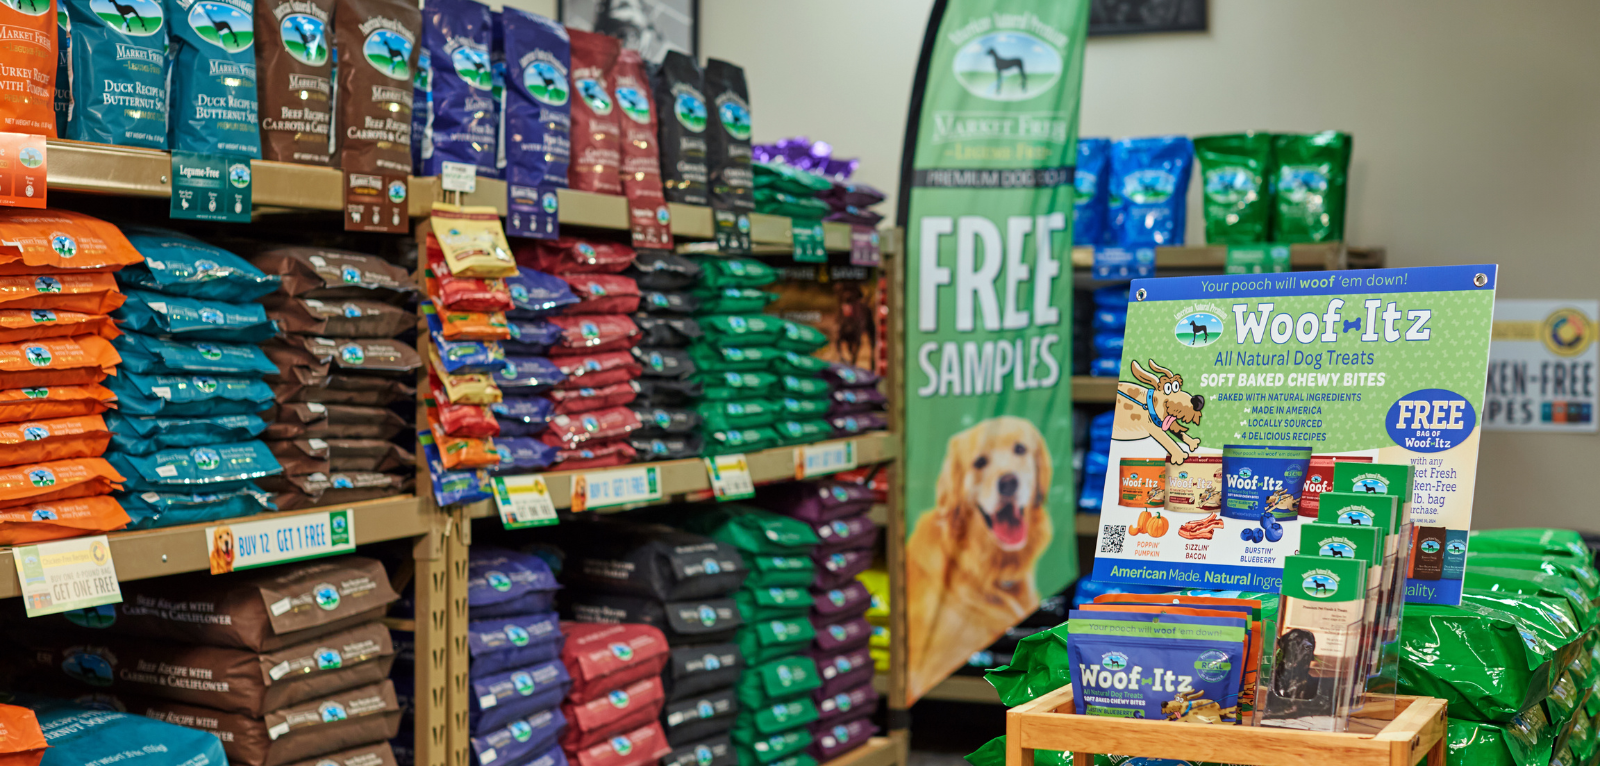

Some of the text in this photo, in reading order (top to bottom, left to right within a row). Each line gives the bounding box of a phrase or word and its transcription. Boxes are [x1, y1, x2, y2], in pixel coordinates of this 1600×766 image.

[117, 45, 147, 60] MARKET
[210, 60, 239, 75] MARKET
[104, 80, 134, 93] DUCK
[103, 93, 154, 109] BUTTERNUT
[198, 94, 226, 106] DUCK
[196, 107, 246, 121] BUTTERNUT
[263, 118, 305, 132] CARROTS
[932, 113, 1013, 142] MARKET
[180, 165, 219, 178] Legume-Free
[926, 170, 998, 186] PREMIUM
[920, 212, 1066, 332] FREE
[1202, 281, 1229, 292] Your
[1232, 278, 1272, 293] pooch
[1275, 277, 1296, 289] will
[1300, 275, 1336, 289] woof
[1366, 273, 1408, 287] down!
[918, 333, 1060, 397] SAMPLES
[1214, 350, 1375, 370] All Natural Dog Treats
[1200, 372, 1386, 387] SOFT BAKED CHEWY BITES
[1218, 393, 1362, 401] BAKED WITH NATURAL INGREDIENTS
[1252, 406, 1322, 414] MADE IN AMERICA
[1396, 400, 1465, 429] FREE
[1482, 401, 1534, 423] PES
[1248, 419, 1323, 428] LOCALLY SOURCED
[1241, 432, 1327, 441] 4 DELICIOUS RECIPES
[1410, 457, 1443, 467] with any
[1414, 468, 1457, 478] ket Fresh
[1413, 481, 1457, 491] ken-Free
[1413, 493, 1445, 507] lb. bag
[238, 523, 326, 557] BUY 12 GET 1 FREE
[1137, 541, 1160, 549] POPPIN'
[1244, 547, 1274, 555] BURSTIN'
[1240, 556, 1276, 564] BLUEBERRY
[50, 574, 62, 583] BUY
[63, 573, 74, 581] ONE
[1110, 565, 1282, 590] American Made. Natural Ingre
[53, 576, 116, 601] GET ONE FREE
[1405, 584, 1437, 600] ality.
[189, 602, 214, 612] WITH
[169, 610, 232, 625] CAULIFLOWER
[1110, 625, 1136, 633] pooch
[1196, 628, 1222, 637] down!
[189, 668, 212, 679] WITH
[168, 676, 229, 692] CAULIFLOWER
[196, 715, 218, 728] WITH
